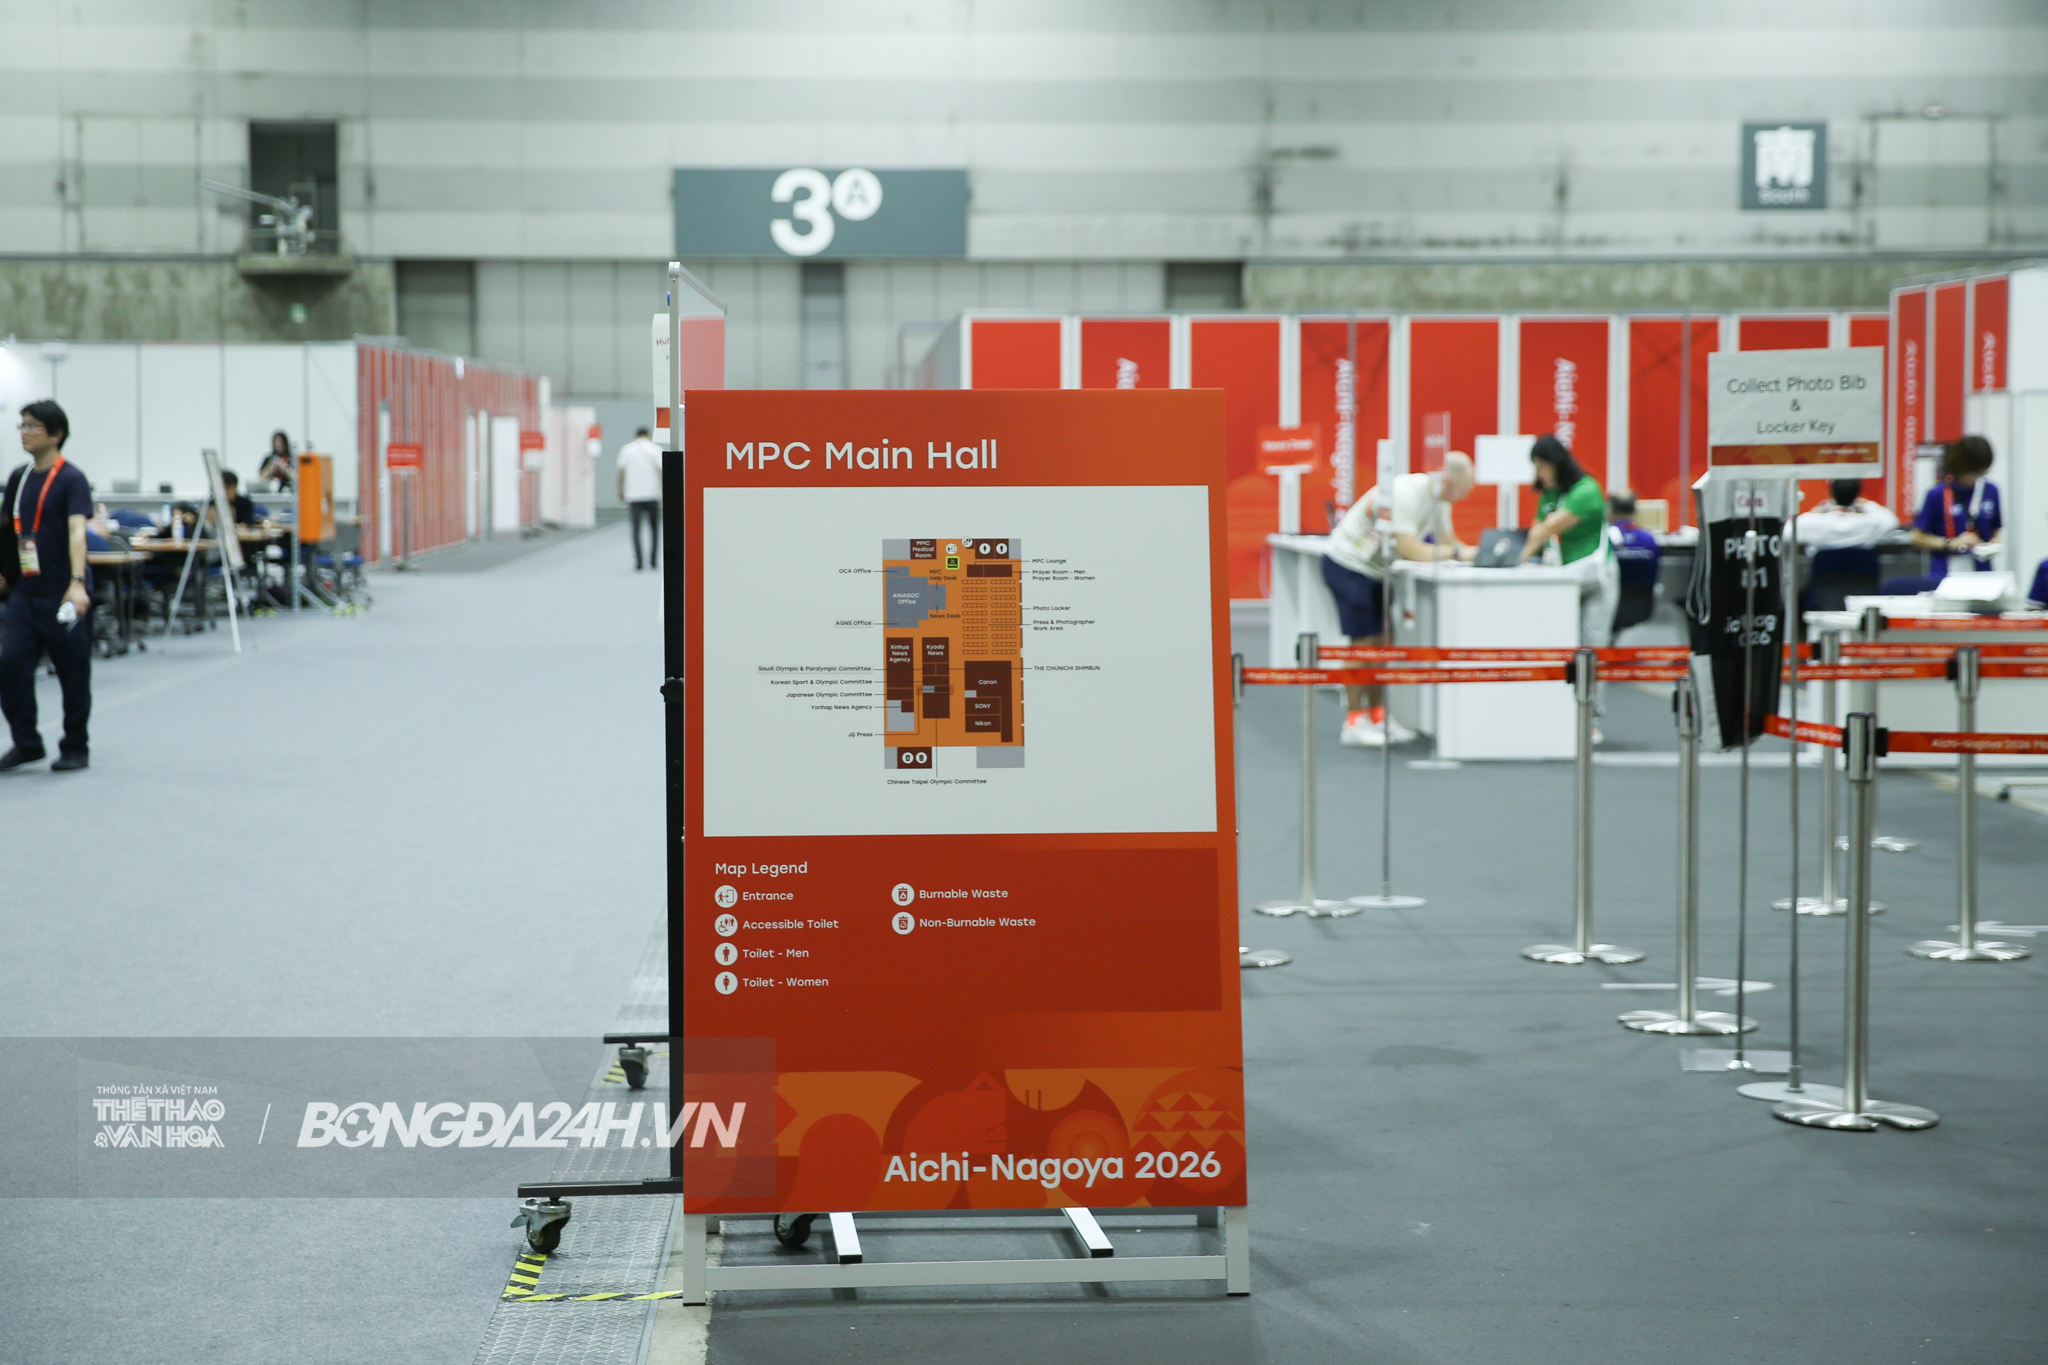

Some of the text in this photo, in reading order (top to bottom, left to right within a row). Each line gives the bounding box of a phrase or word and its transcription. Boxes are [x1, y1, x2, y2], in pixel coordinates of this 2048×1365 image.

[770, 168, 835, 257] 3
[1727, 375, 1867, 394] Collect Photo Bib
[1790, 398, 1801, 412] &
[1756, 419, 1836, 435] Locker Key
[726, 438, 997, 470] MPC Main Hall
[715, 861, 808, 878] Map Legend
[742, 892, 794, 900] Entrance
[919, 889, 1009, 898] Burnable Waste
[742, 919, 839, 929] Accessible Toilet
[919, 917, 1036, 927] Non-Burnable Waste
[742, 949, 774, 958] Toilet
[786, 949, 809, 958] Men
[742, 978, 774, 987] Toilet
[786, 977, 829, 986] Women
[883, 1150, 1222, 1189] Aichi-Nagoya 2026
